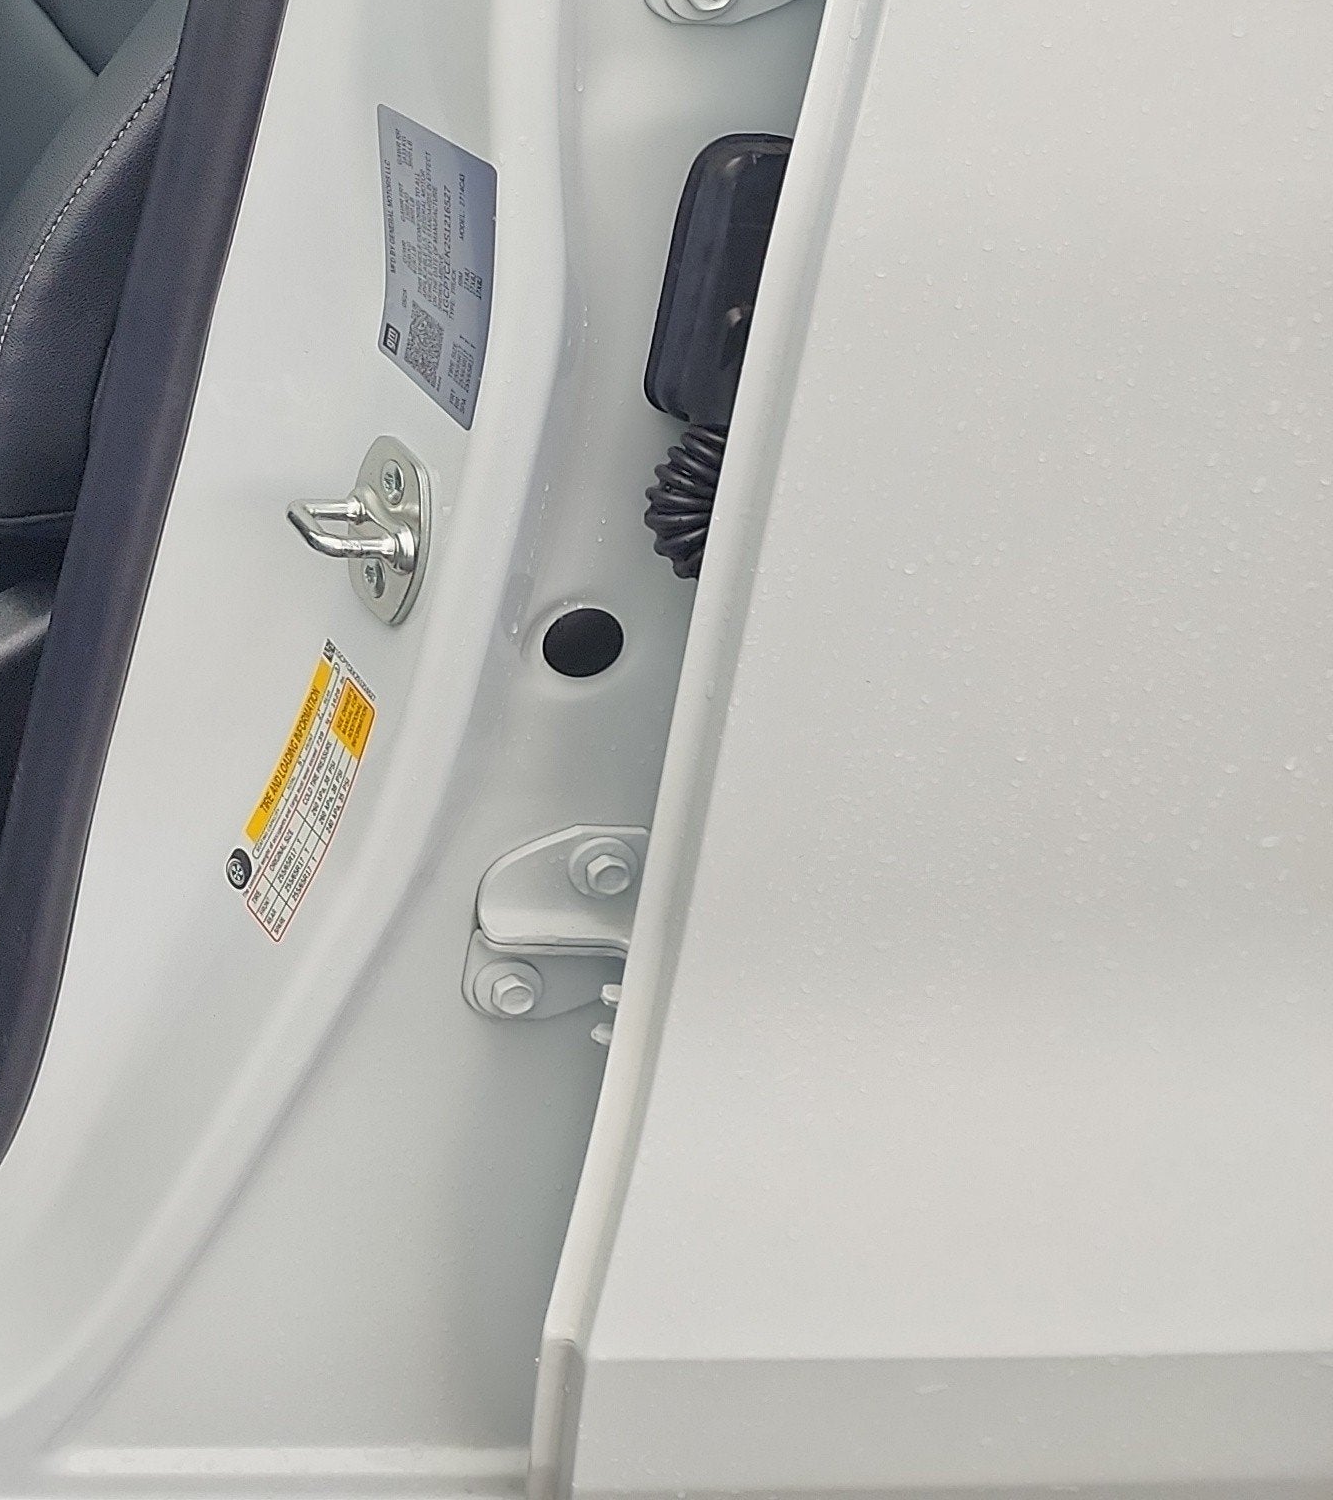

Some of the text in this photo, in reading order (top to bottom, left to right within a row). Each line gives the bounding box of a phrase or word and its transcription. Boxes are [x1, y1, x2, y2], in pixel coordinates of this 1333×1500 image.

[387, 208, 395, 245] GENERAL
[389, 244, 395, 257] BY
[259, 684, 320, 815] TIRE AND LOADING INFORMATION
[301, 785, 313, 806] COLD
